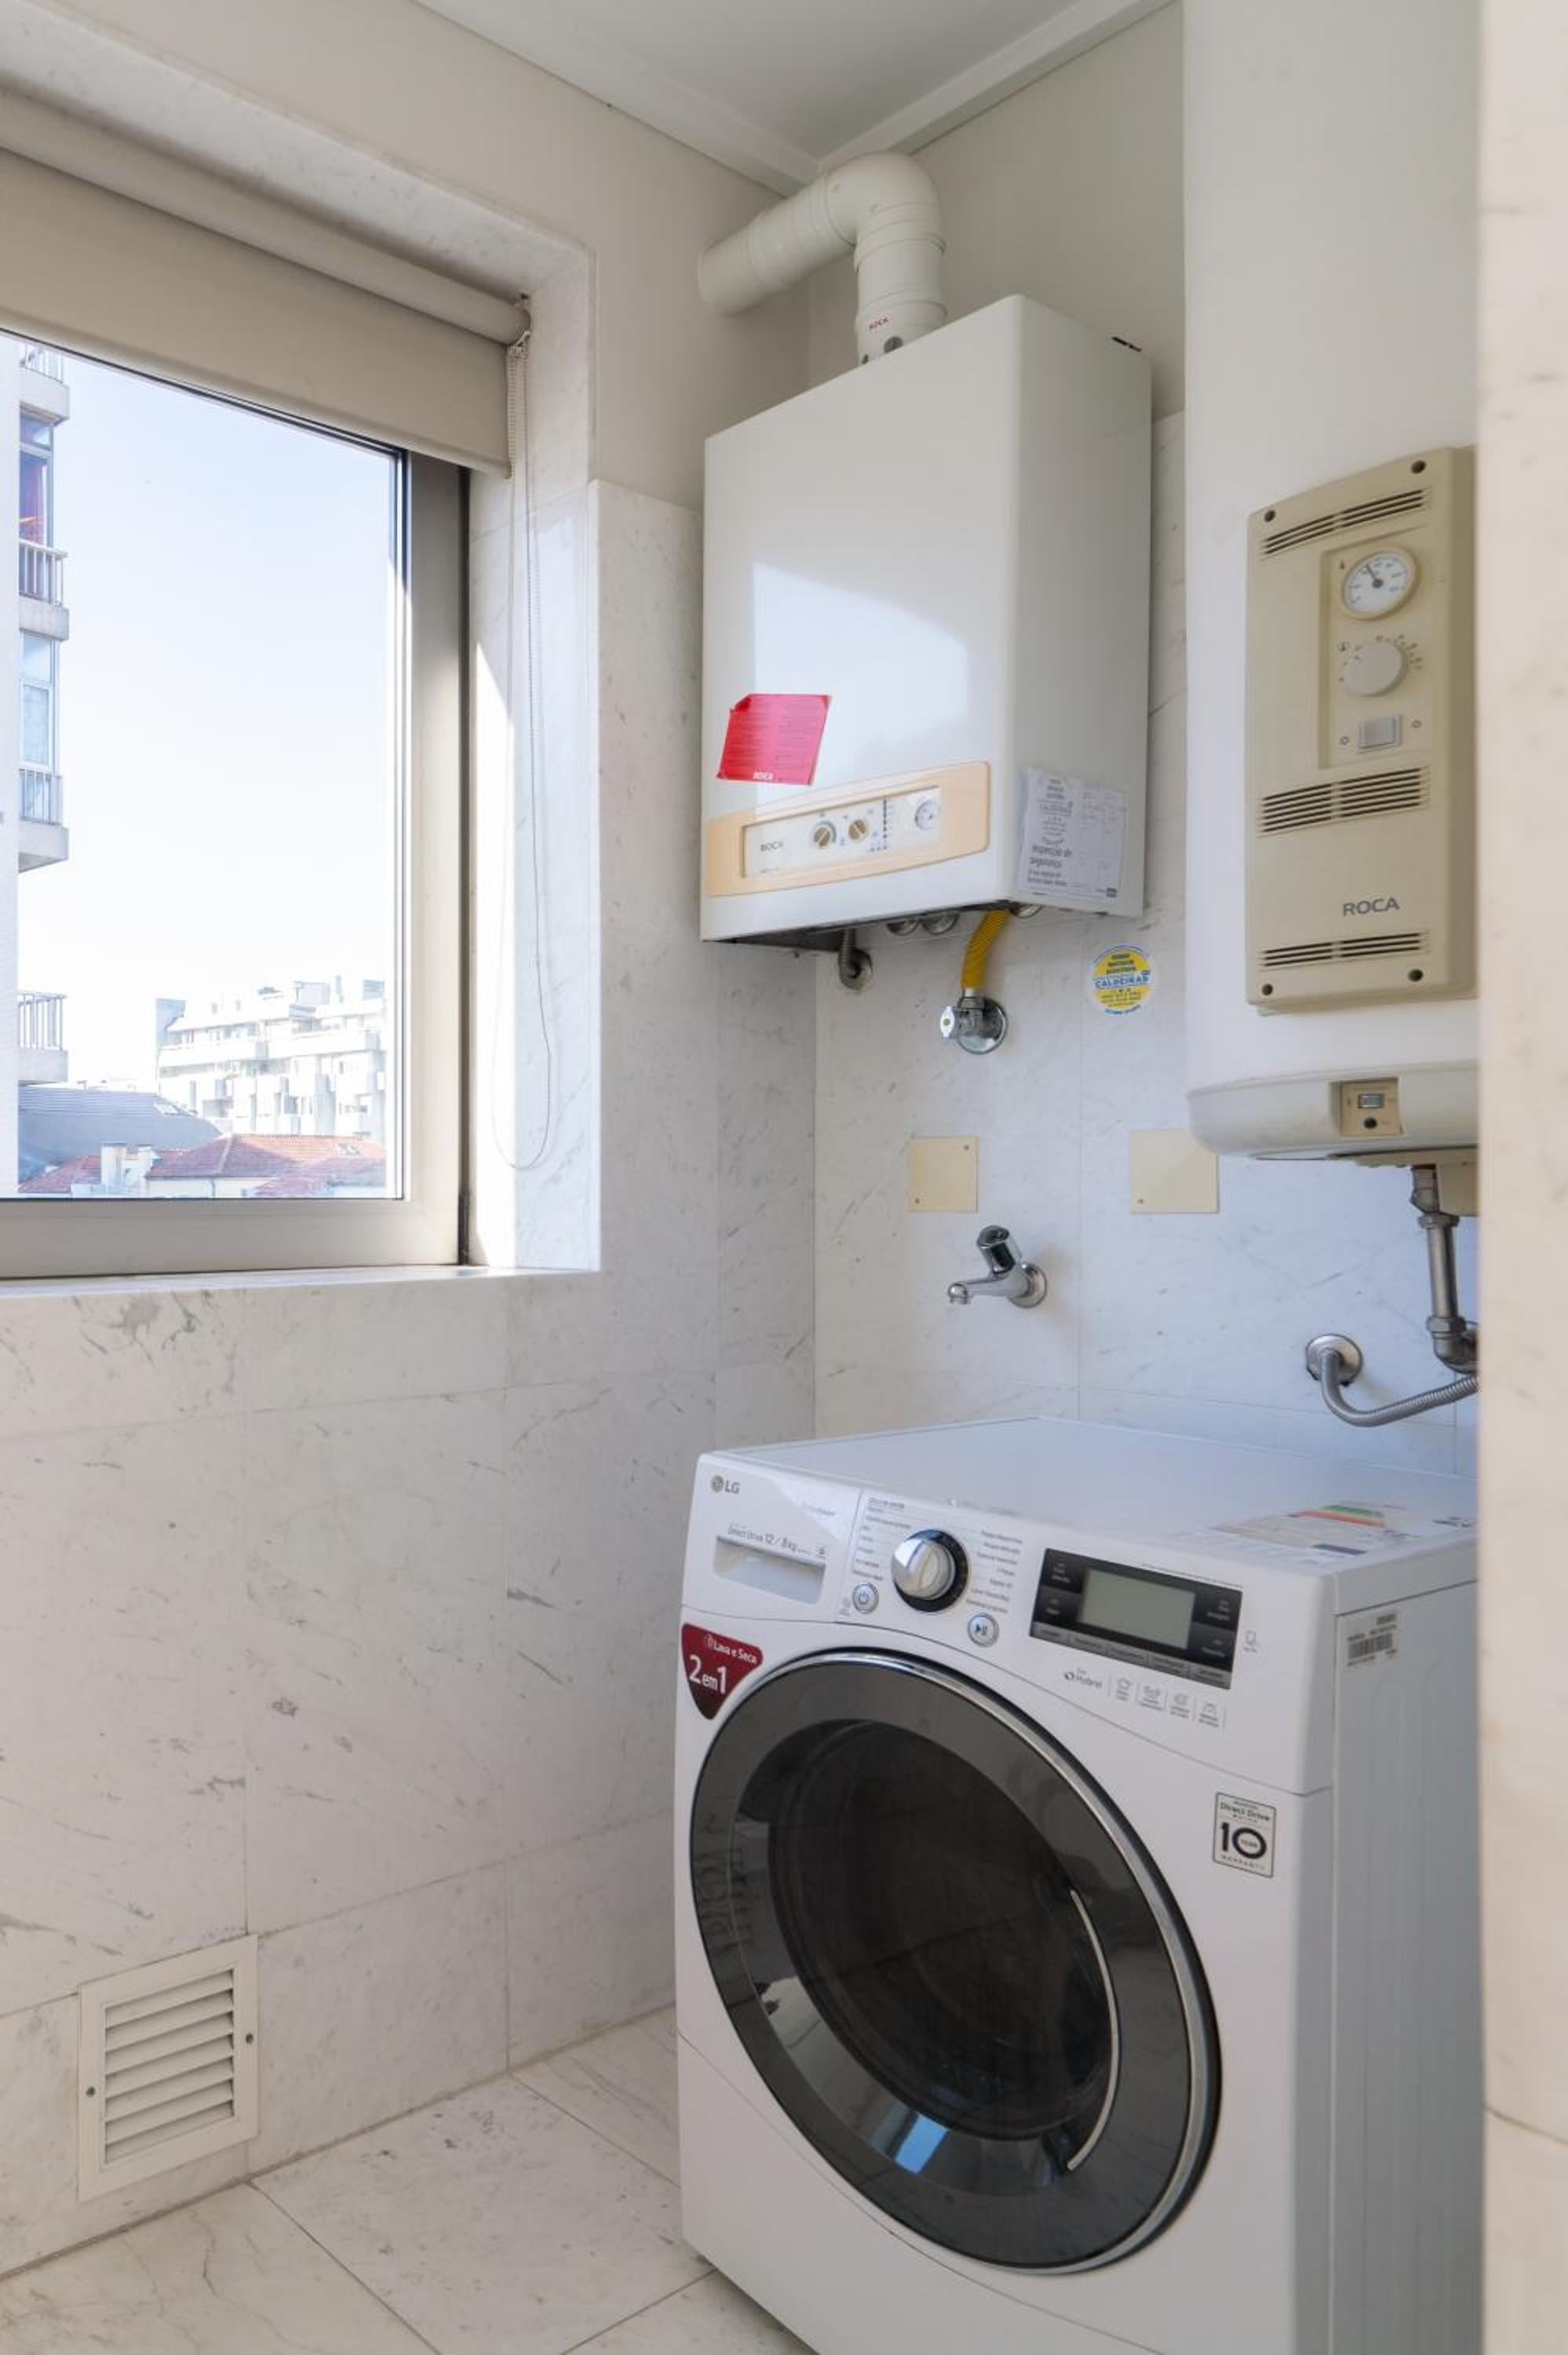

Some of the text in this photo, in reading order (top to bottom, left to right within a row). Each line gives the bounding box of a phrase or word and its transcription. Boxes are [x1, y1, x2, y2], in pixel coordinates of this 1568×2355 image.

[760, 840, 785, 853] ROCA
[1343, 897, 1400, 917] ROCA
[725, 1480, 741, 1494] LG
[731, 1649, 737, 1658] e
[738, 1648, 757, 1664] Seca
[1220, 1822, 1267, 1860] 10
